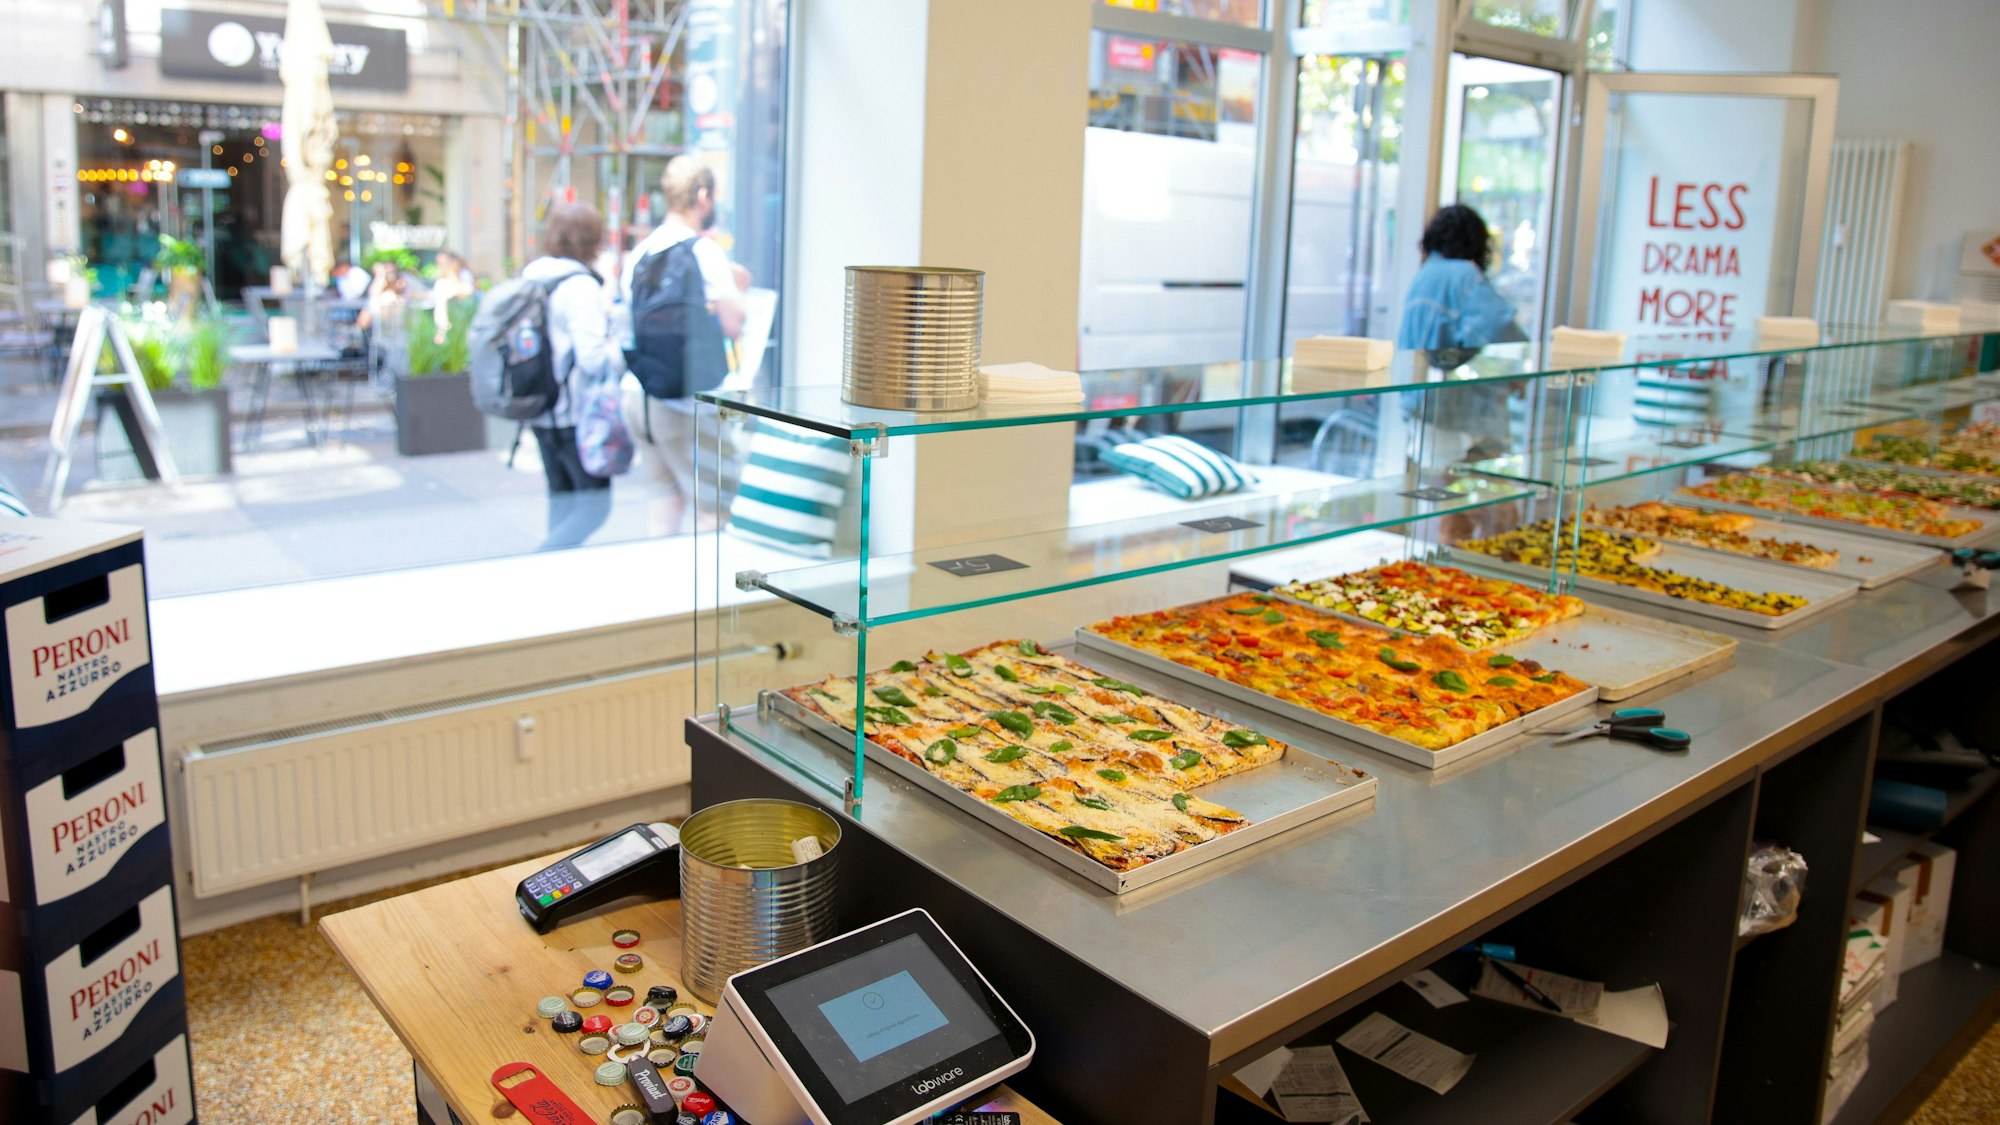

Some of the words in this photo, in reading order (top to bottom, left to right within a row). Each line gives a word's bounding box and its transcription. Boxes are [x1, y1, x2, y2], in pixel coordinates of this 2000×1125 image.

[1648, 175, 1748, 230] LESS
[1641, 242, 1740, 276] DRAMA
[1638, 287, 1737, 327] MORE
[32, 617, 132, 679] PERONI
[46, 661, 122, 702] AZZURRO
[57, 655, 109, 683] NASTRO
[52, 781, 148, 855] PERONI
[76, 820, 126, 854] NASTRO
[66, 825, 138, 876] AZZURRO
[70, 938, 163, 1022] PERONI
[93, 979, 141, 1018] NASTRO
[83, 981, 152, 1041] AZZURRO
[634, 1068, 667, 1101] Proviant
[911, 1066, 964, 1095] labware
